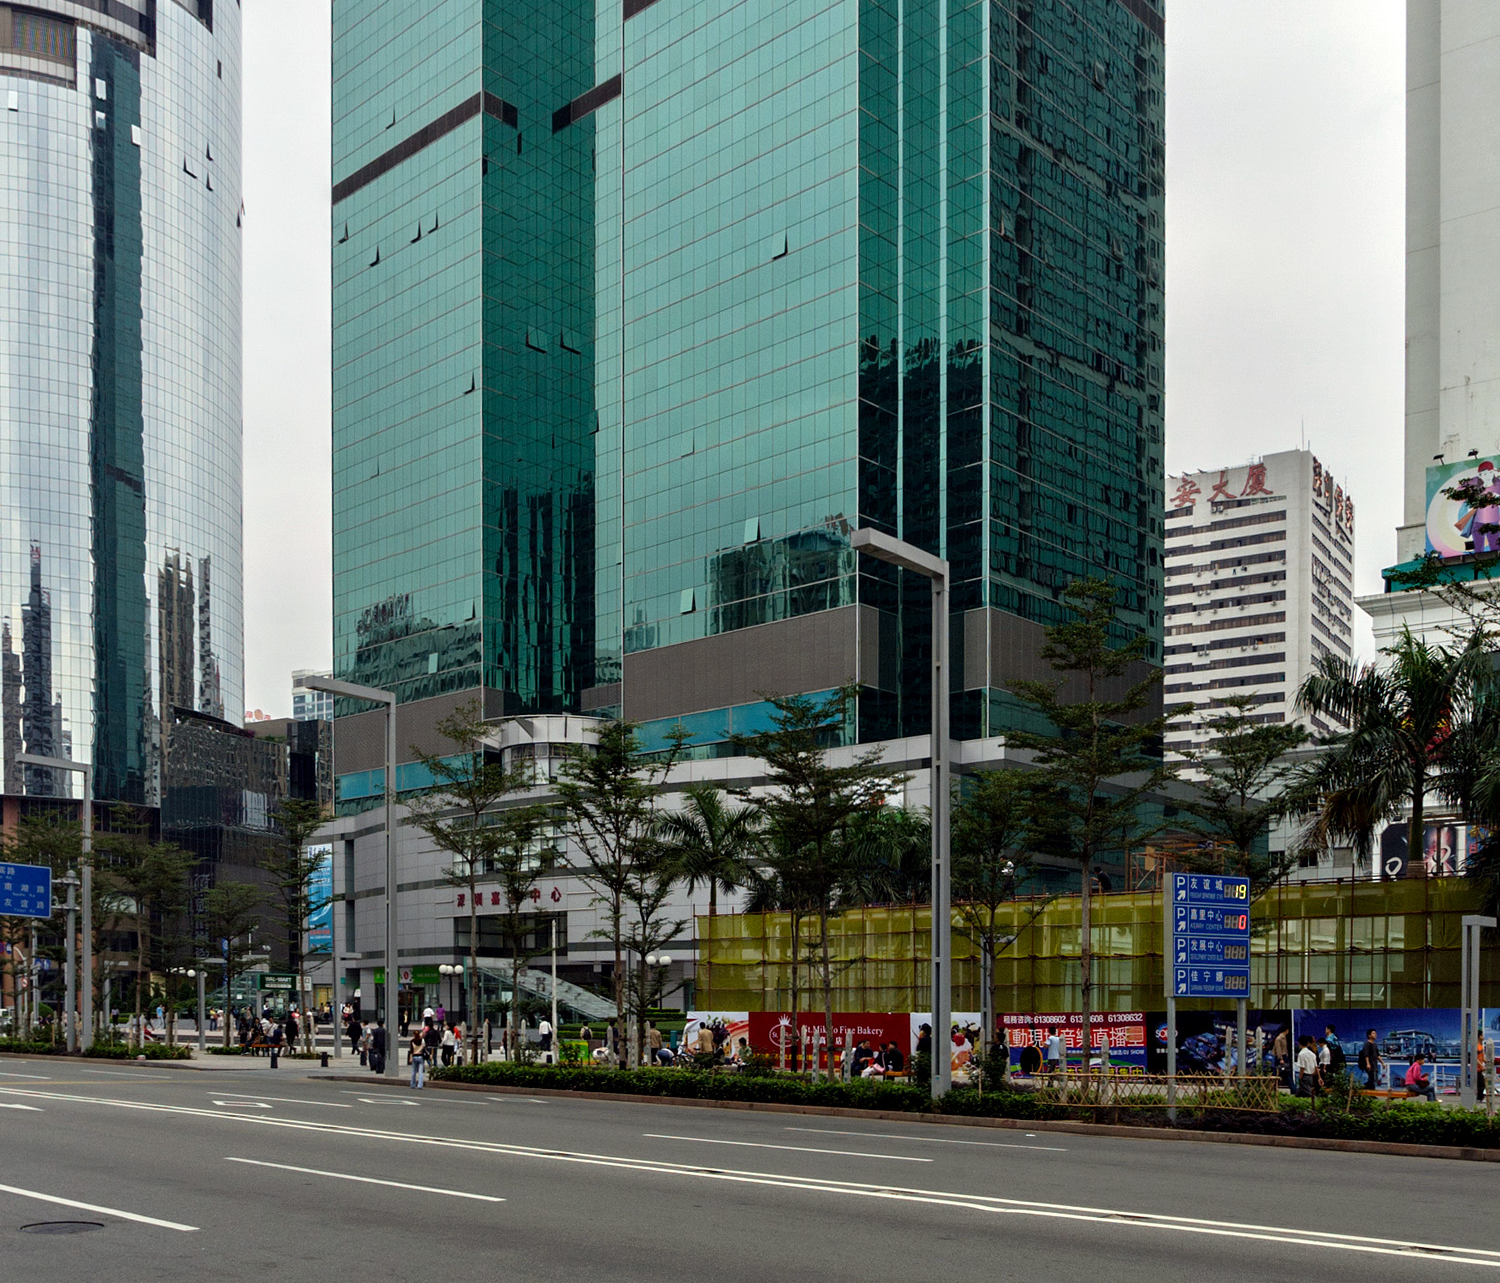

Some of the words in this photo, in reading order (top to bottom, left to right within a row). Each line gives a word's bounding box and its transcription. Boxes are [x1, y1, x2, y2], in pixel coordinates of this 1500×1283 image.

[1170, 462, 1273, 507] 安大厦
[1177, 877, 1186, 888] P
[457, 886, 562, 908] 深圳嘉中心
[1235, 884, 1247, 899] 19
[1177, 908, 1186, 919] P
[1190, 909, 1223, 922] 嘉里中心
[1177, 939, 1186, 950] P
[1177, 970, 1186, 981] P
[1070, 1014, 1104, 1024] 613608
[857, 1026, 884, 1037] Bakery
